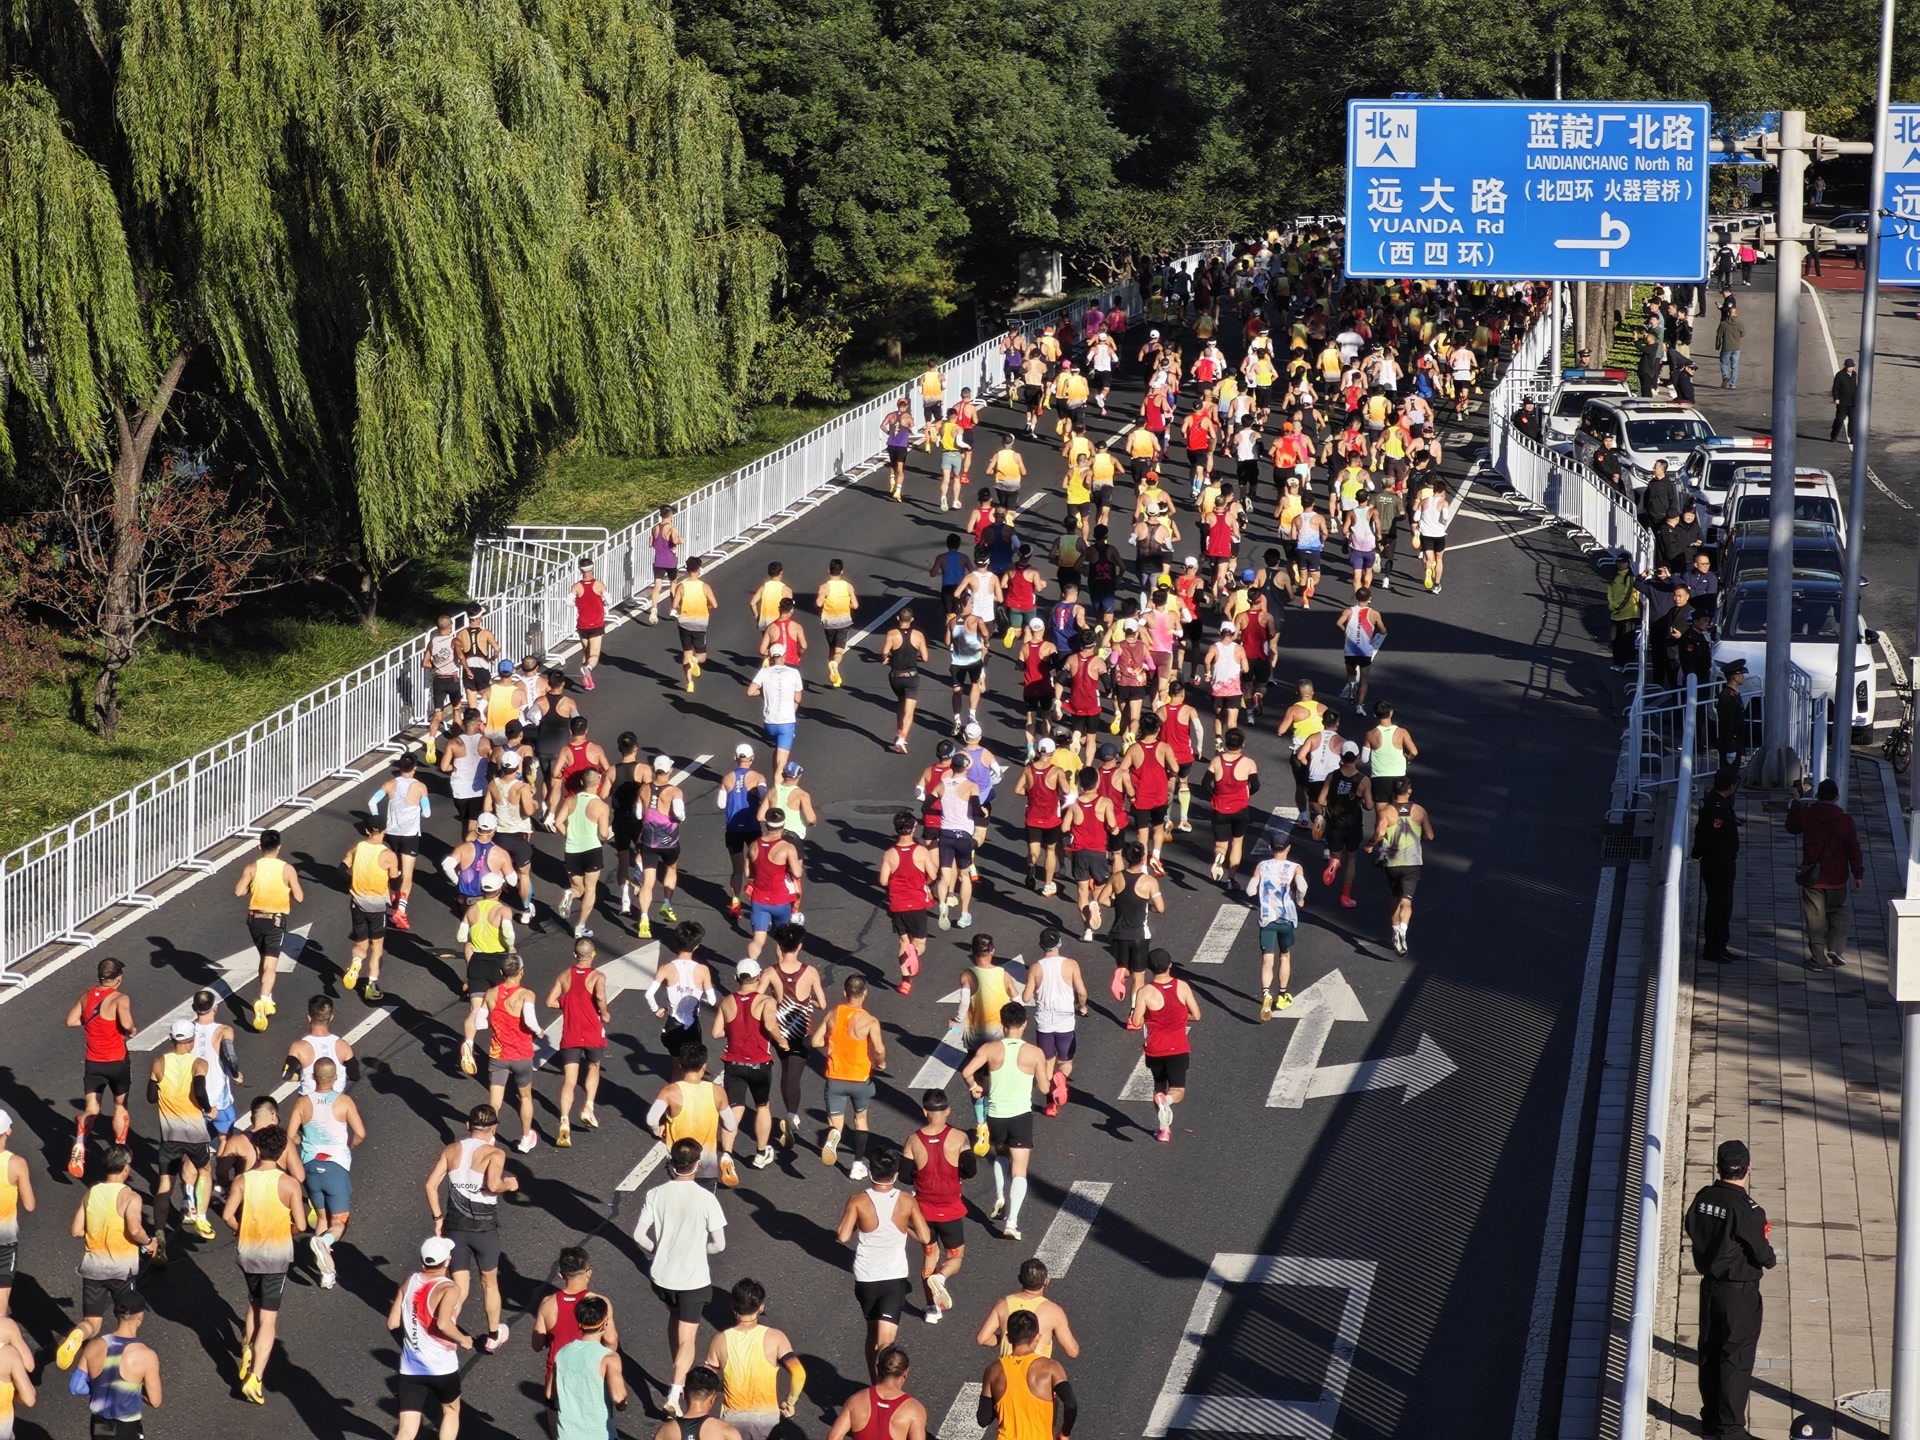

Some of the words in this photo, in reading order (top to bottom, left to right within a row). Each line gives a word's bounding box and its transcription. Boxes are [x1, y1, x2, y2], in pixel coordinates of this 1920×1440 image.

[1365, 112, 1392, 139] 北
[1527, 112, 1695, 151] 蓝靛厂北路
[1526, 155, 1628, 171] LANDIANCHANG
[1635, 156, 1670, 171] North
[1677, 157, 1693, 171] Rd
[1367, 177, 1508, 214] 远大路
[1368, 218, 1464, 234] YUANDA
[1477, 219, 1504, 234] Rd
